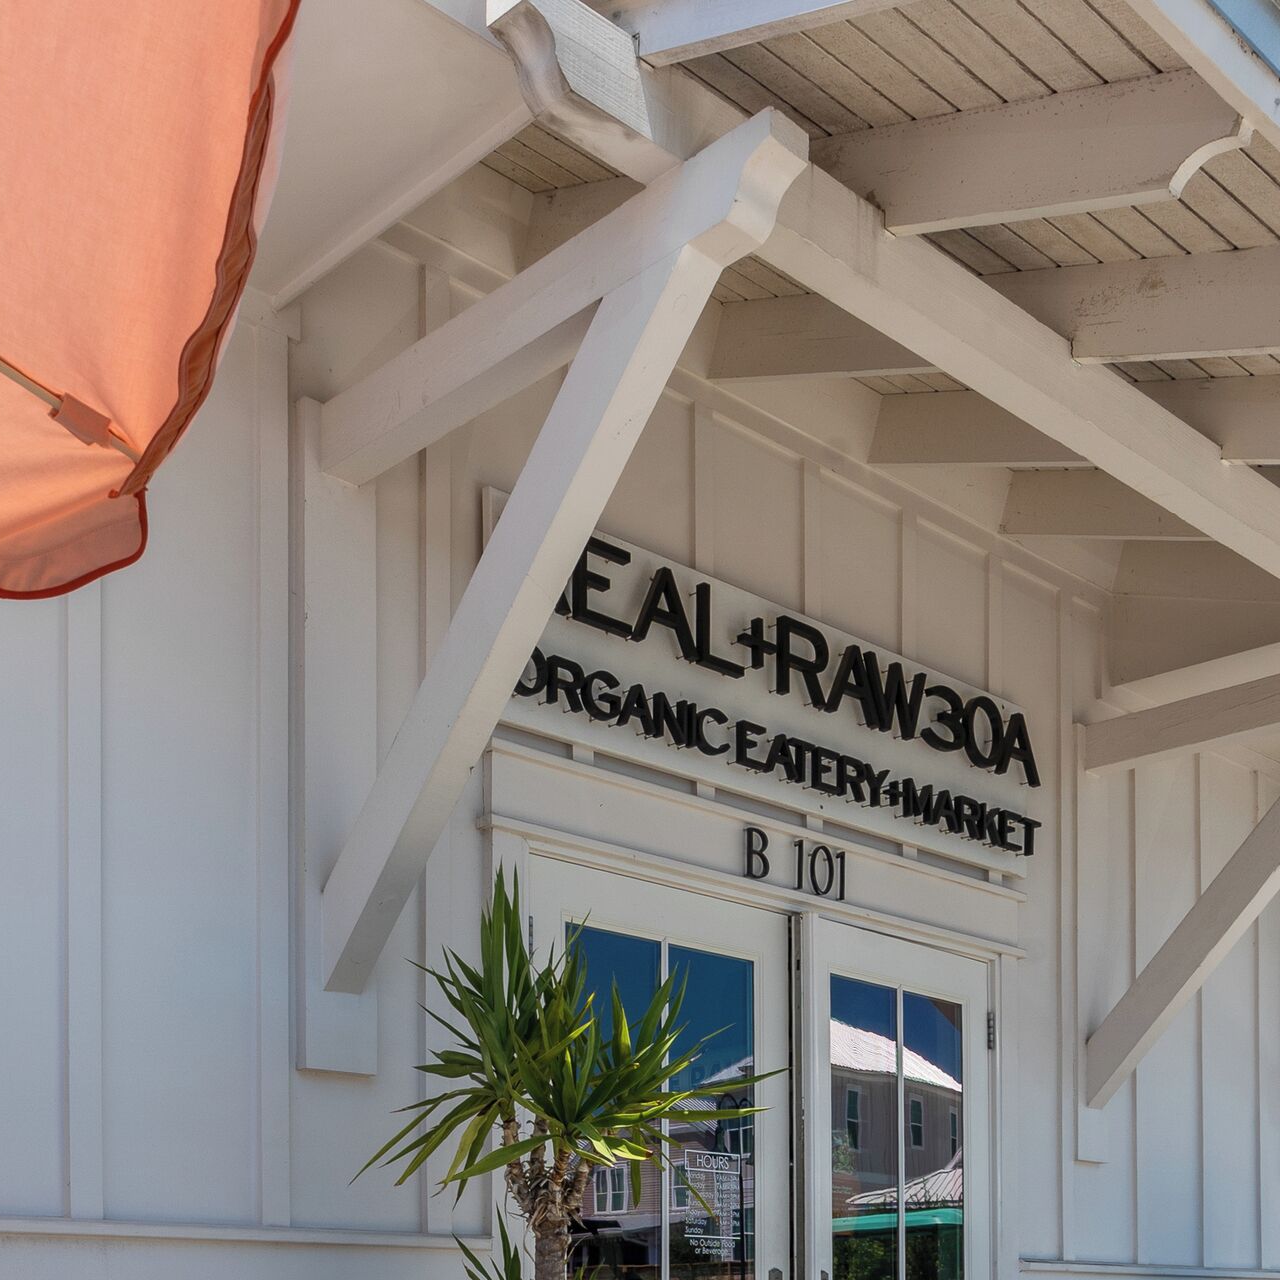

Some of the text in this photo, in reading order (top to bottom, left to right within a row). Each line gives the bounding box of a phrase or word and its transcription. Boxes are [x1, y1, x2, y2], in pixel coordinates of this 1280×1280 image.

[555, 537, 1041, 788] EAL+RAW30A
[513, 646, 731, 757] ORGANIC
[744, 827, 846, 901] B 101
[696, 1154, 729, 1169] HOURS
[685, 1226, 704, 1234] Sunday
